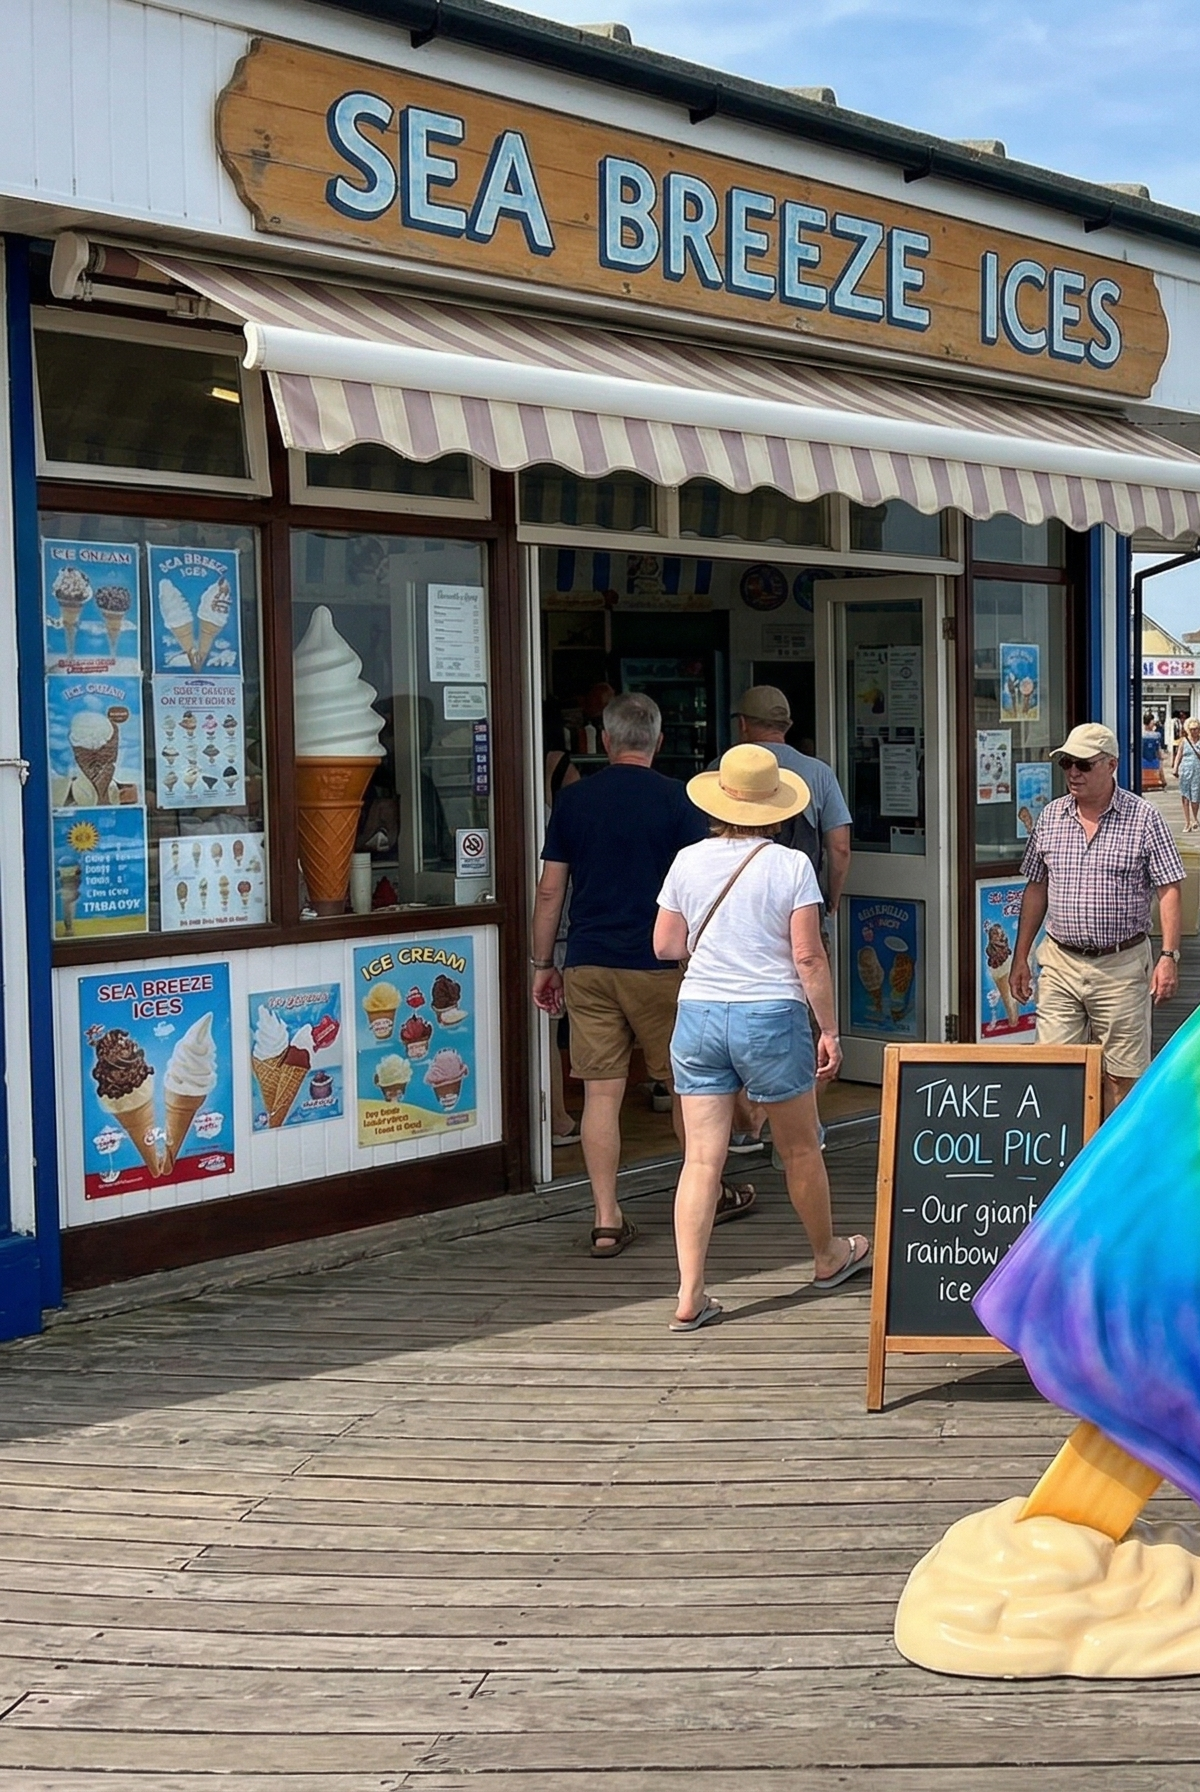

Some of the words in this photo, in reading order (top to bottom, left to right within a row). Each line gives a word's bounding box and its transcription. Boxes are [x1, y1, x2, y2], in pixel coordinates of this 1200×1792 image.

[326, 90, 555, 257] SEA
[598, 156, 931, 332] BREEZE
[981, 250, 1123, 370] ICES
[361, 953, 395, 981] ICE
[398, 946, 467, 974] CREAM
[98, 982, 138, 1002] SEA
[142, 974, 213, 998] BREEZE
[132, 998, 183, 1020] ICES
[915, 1078, 1002, 1118] TAKE
[1016, 1084, 1041, 1119] A
[913, 1129, 993, 1165] COOL
[1004, 1123, 1071, 1168] PIC!
[973, 1195, 1038, 1237] giant
[906, 1236, 999, 1266] rainbow
[939, 1276, 972, 1302] ice
